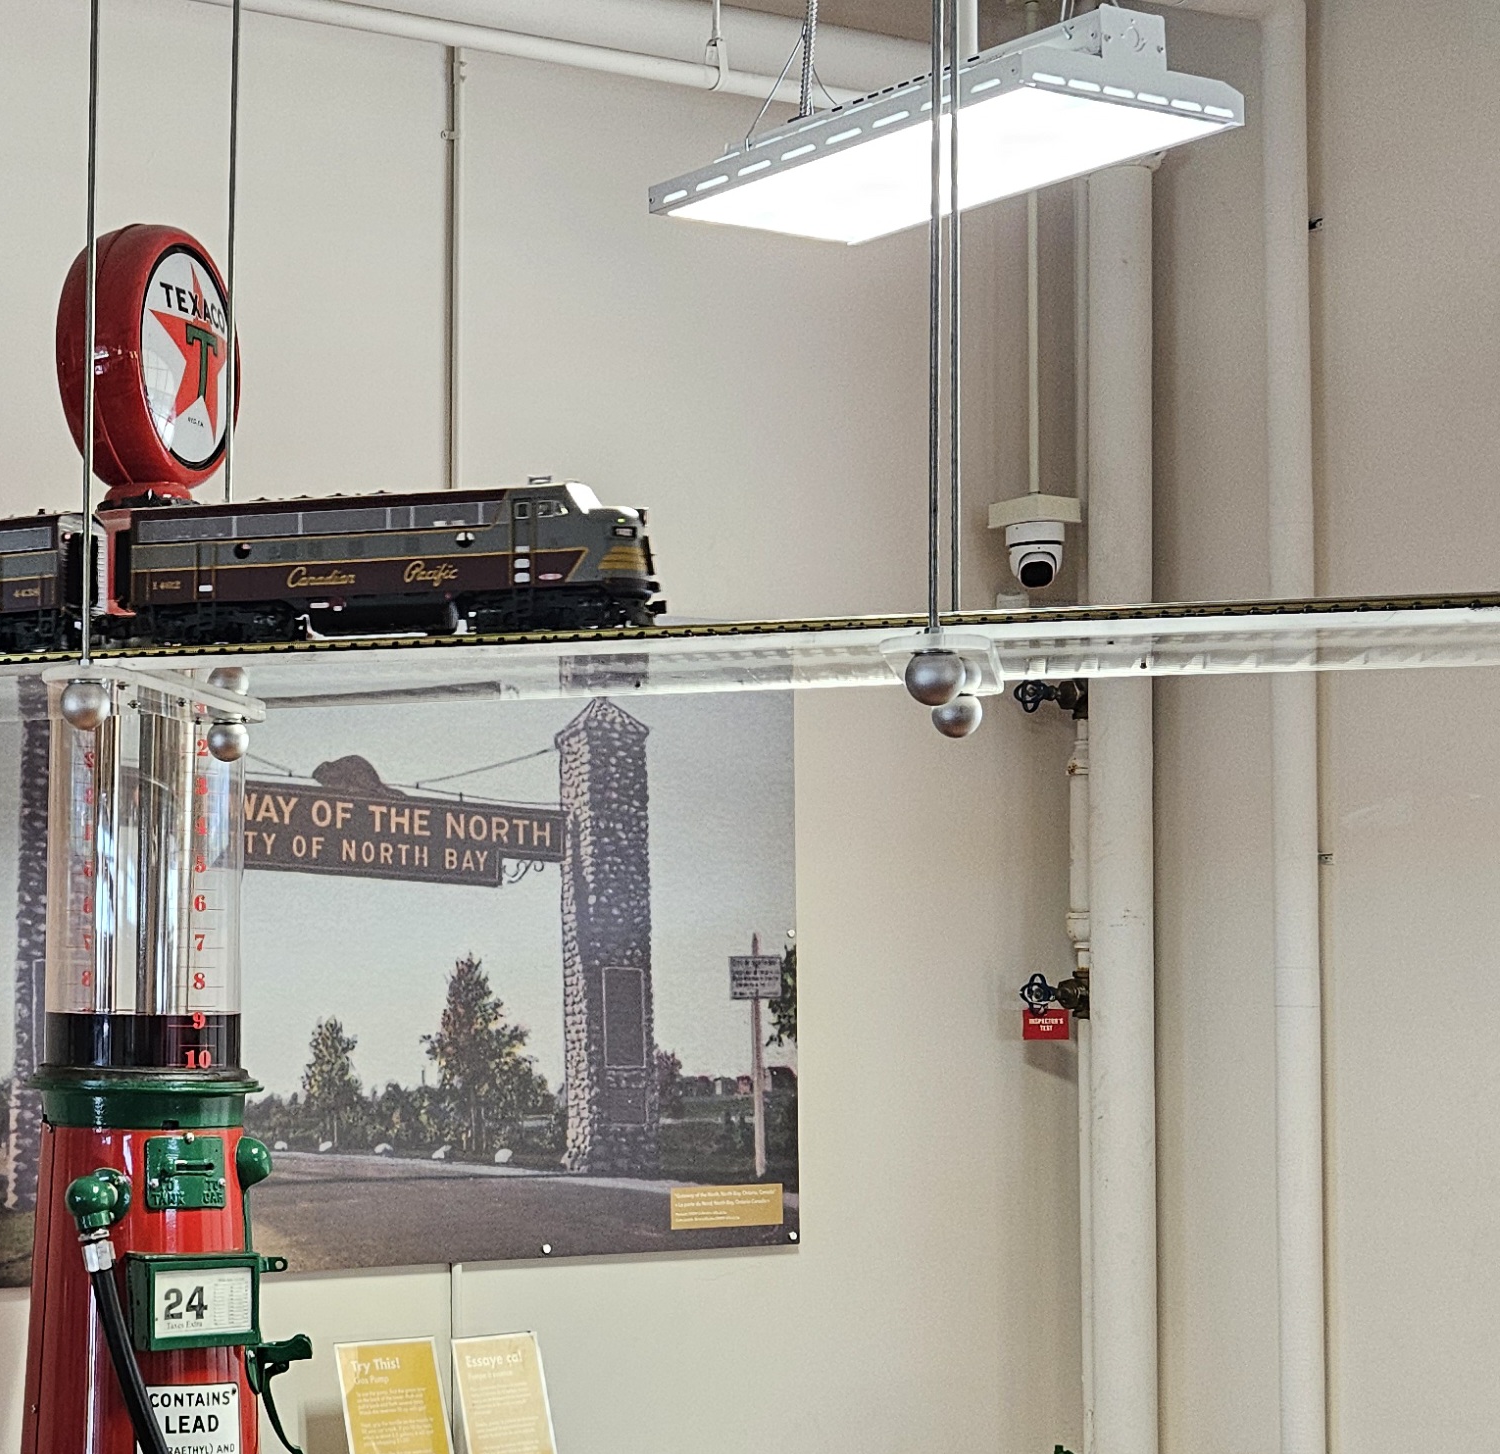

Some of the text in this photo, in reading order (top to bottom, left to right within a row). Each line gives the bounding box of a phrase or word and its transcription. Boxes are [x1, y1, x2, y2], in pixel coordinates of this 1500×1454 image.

[160, 281, 227, 332] TEXACO
[186, 322, 219, 400] T
[286, 560, 460, 590] Canadian Pacific
[311, 799, 354, 830] OF
[368, 805, 431, 836] THE
[446, 811, 551, 848] NORTH
[292, 835, 325, 859] OF
[342, 839, 428, 868] NORTH
[444, 848, 489, 872] BAY
[194, 895, 207, 912] 6
[194, 934, 206, 951] 7
[193, 972, 206, 990] 8
[192, 1011, 206, 1029] 9
[184, 1050, 212, 1069] 10
[350, 1357, 400, 1374] Try This!
[465, 1354, 504, 1369] Essaye
[370, 1375, 390, 1386] Pump
[150, 1391, 231, 1408] CONTAINS
[165, 1414, 220, 1434] LEAD
[216, 1443, 235, 1454] AND
